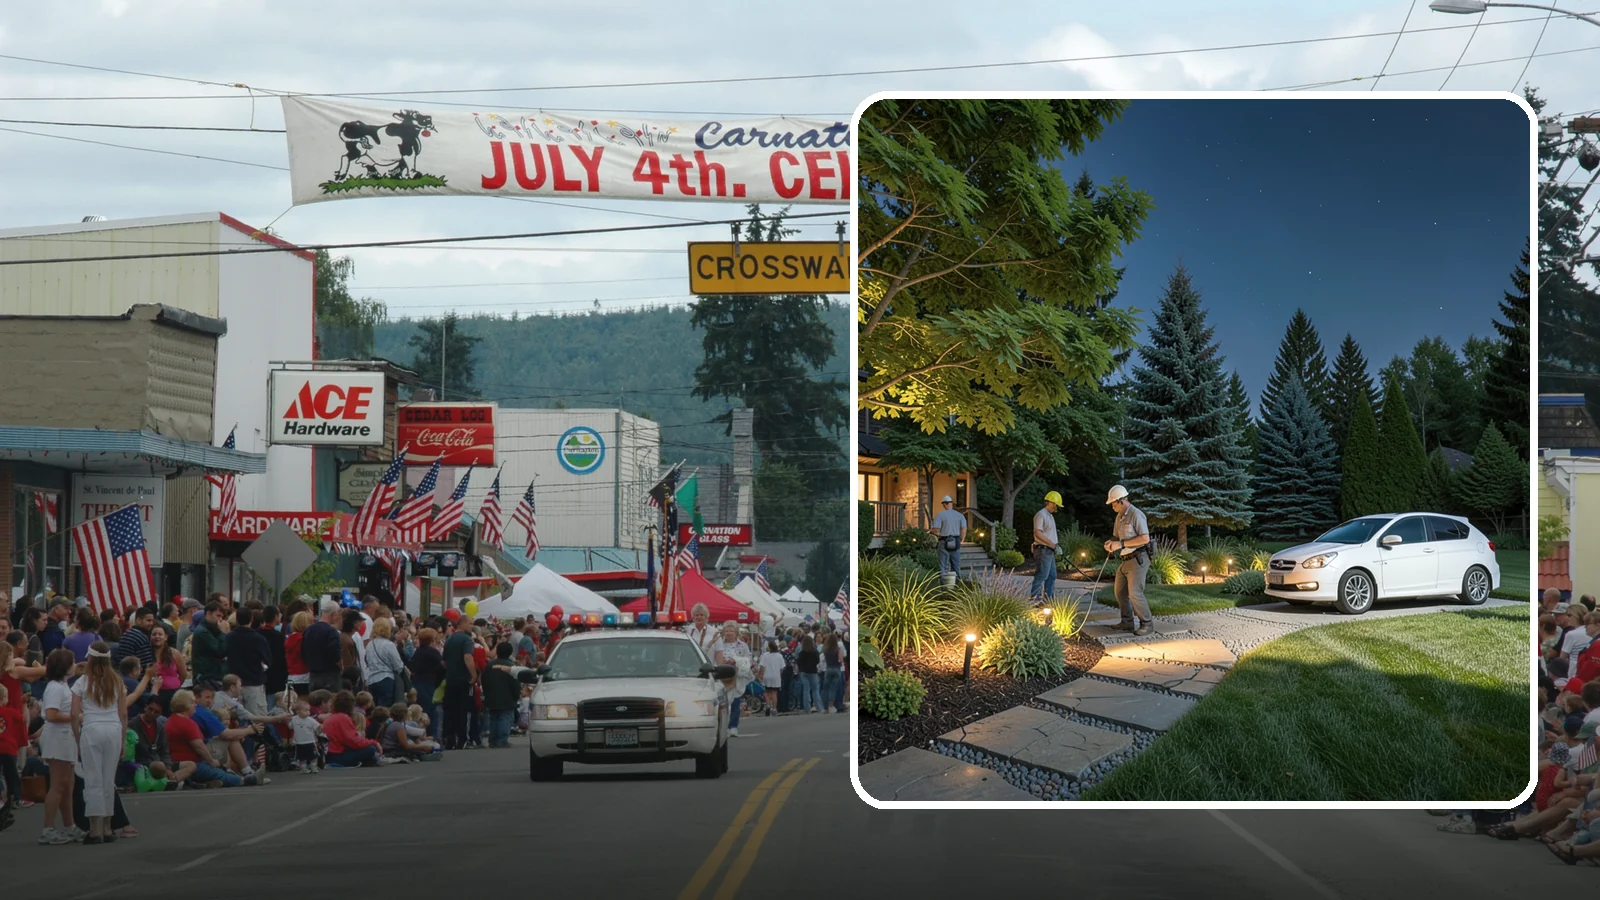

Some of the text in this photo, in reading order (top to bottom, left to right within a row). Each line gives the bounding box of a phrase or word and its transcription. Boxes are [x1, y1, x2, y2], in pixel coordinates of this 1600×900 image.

[695, 121, 850, 150] Carnat
[481, 141, 604, 192] JULY
[632, 150, 746, 198] 4th.
[697, 254, 850, 280] CROSSWA
[282, 380, 373, 420] ACE
[405, 409, 485, 422] CEDAR LOG
[283, 421, 371, 436] Hardware
[354, 467, 384, 481] Simpl
[83, 484, 155, 495] St. Vincent de Paul
[688, 526, 741, 535] CRNATION
[699, 535, 730, 543] GLASS
